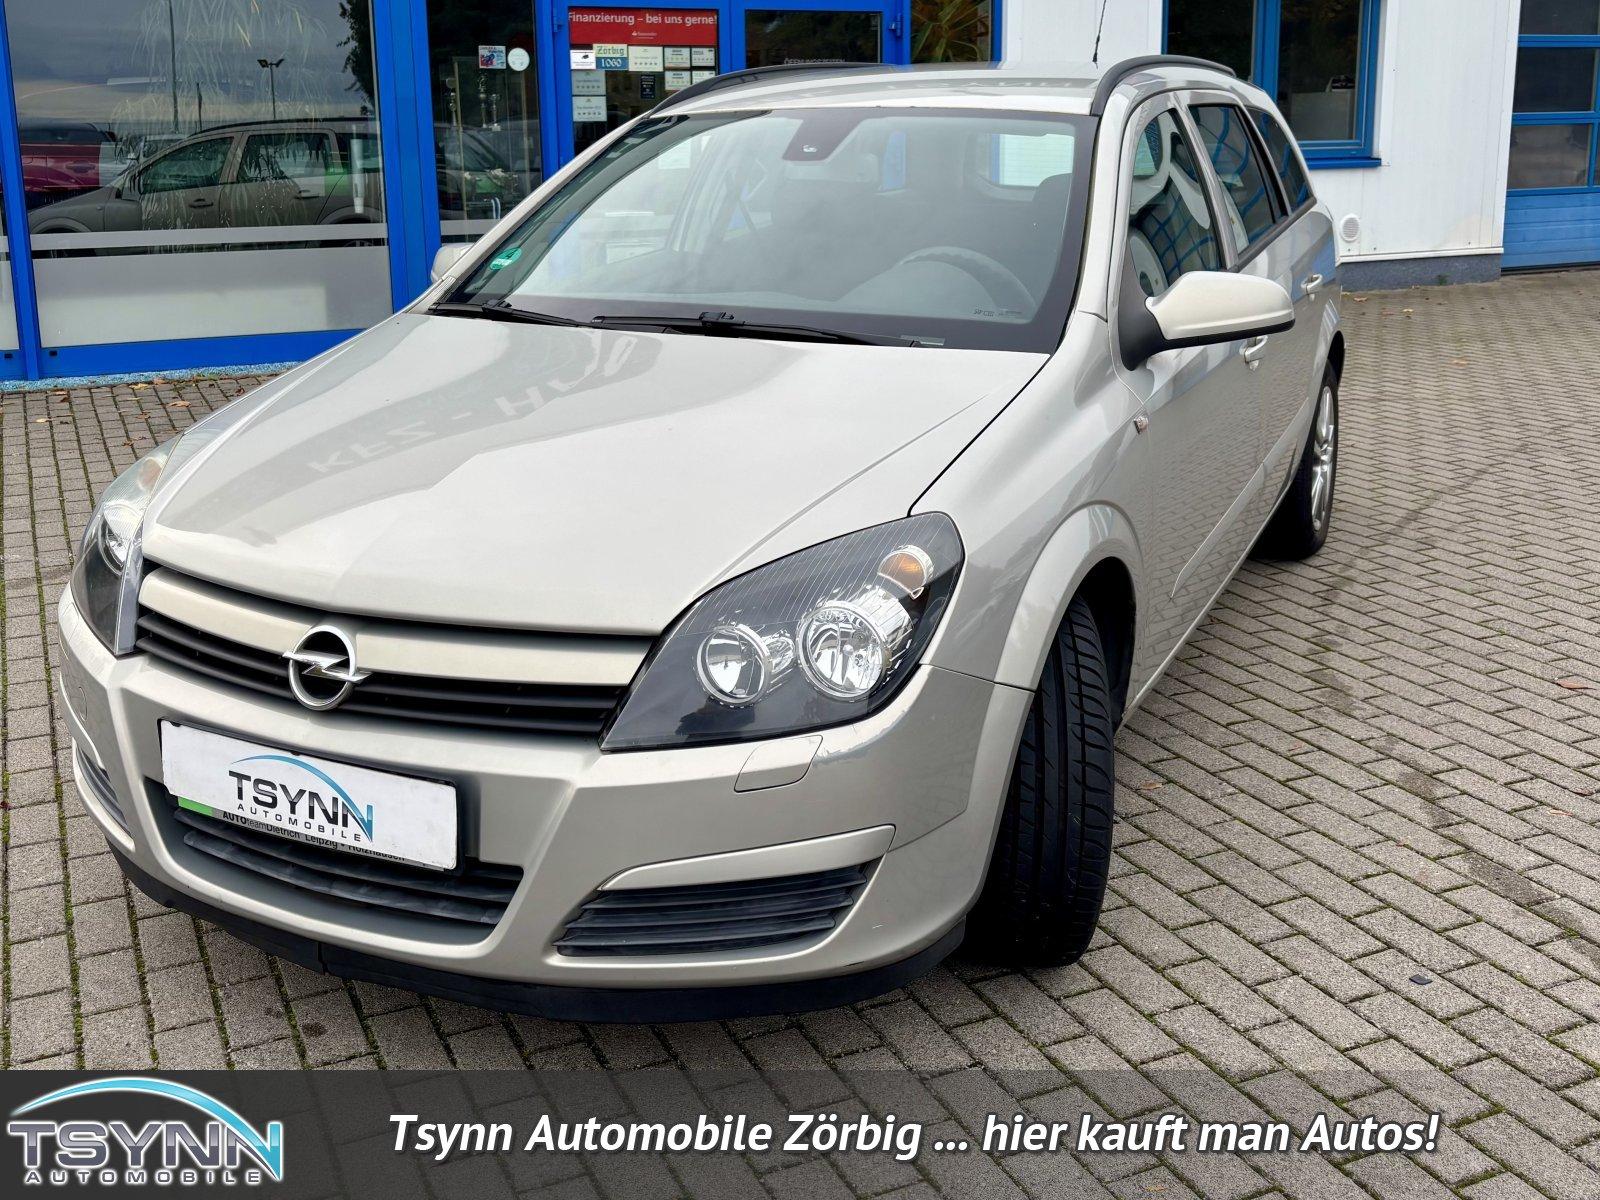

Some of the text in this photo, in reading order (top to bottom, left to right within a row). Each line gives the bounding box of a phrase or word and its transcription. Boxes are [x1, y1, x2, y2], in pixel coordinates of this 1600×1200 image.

[568, 12, 635, 25] Finanzierung
[646, 14, 662, 24] bei
[664, 16, 682, 24] uns
[685, 15, 717, 26] gerne!
[228, 769, 374, 843] TSYNN
[237, 803, 362, 842] AUTOMOBILE
